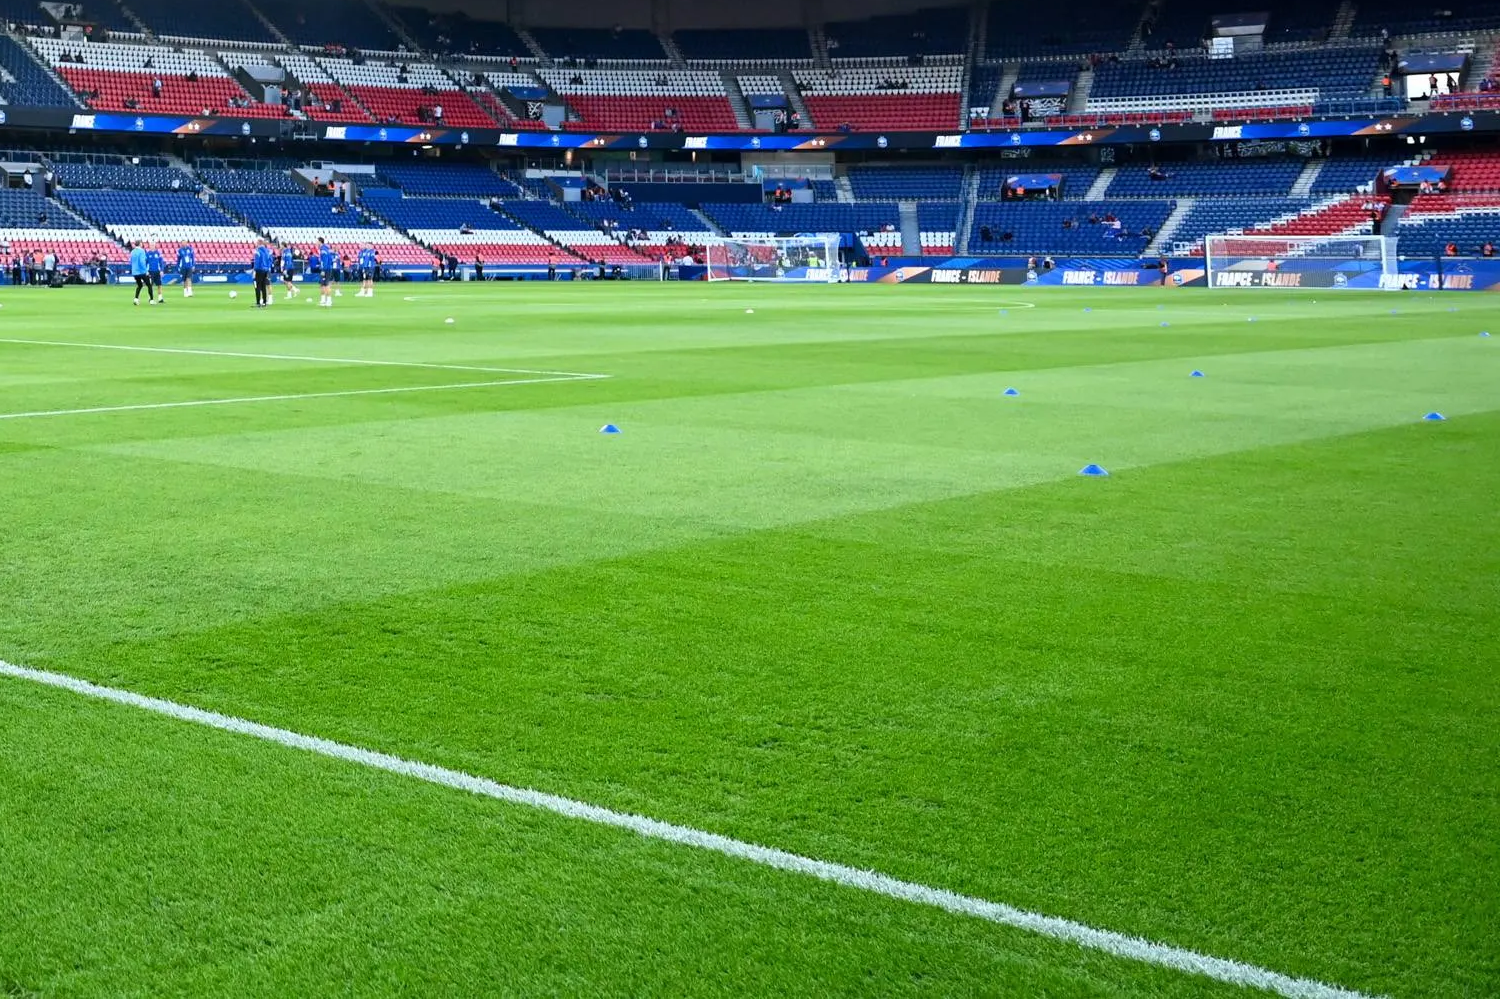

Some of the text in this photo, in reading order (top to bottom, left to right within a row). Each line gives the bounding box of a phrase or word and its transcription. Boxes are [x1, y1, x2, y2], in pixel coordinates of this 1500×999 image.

[1213, 126, 1243, 140] FRANCE
[935, 135, 963, 148] FRANCE
[931, 269, 962, 283] FRANCE
[968, 270, 1001, 283] ISLANDE
[1062, 270, 1095, 284] FRANCE
[1103, 271, 1139, 285] ISLANDE
[1261, 273, 1302, 286] ISLANDE
